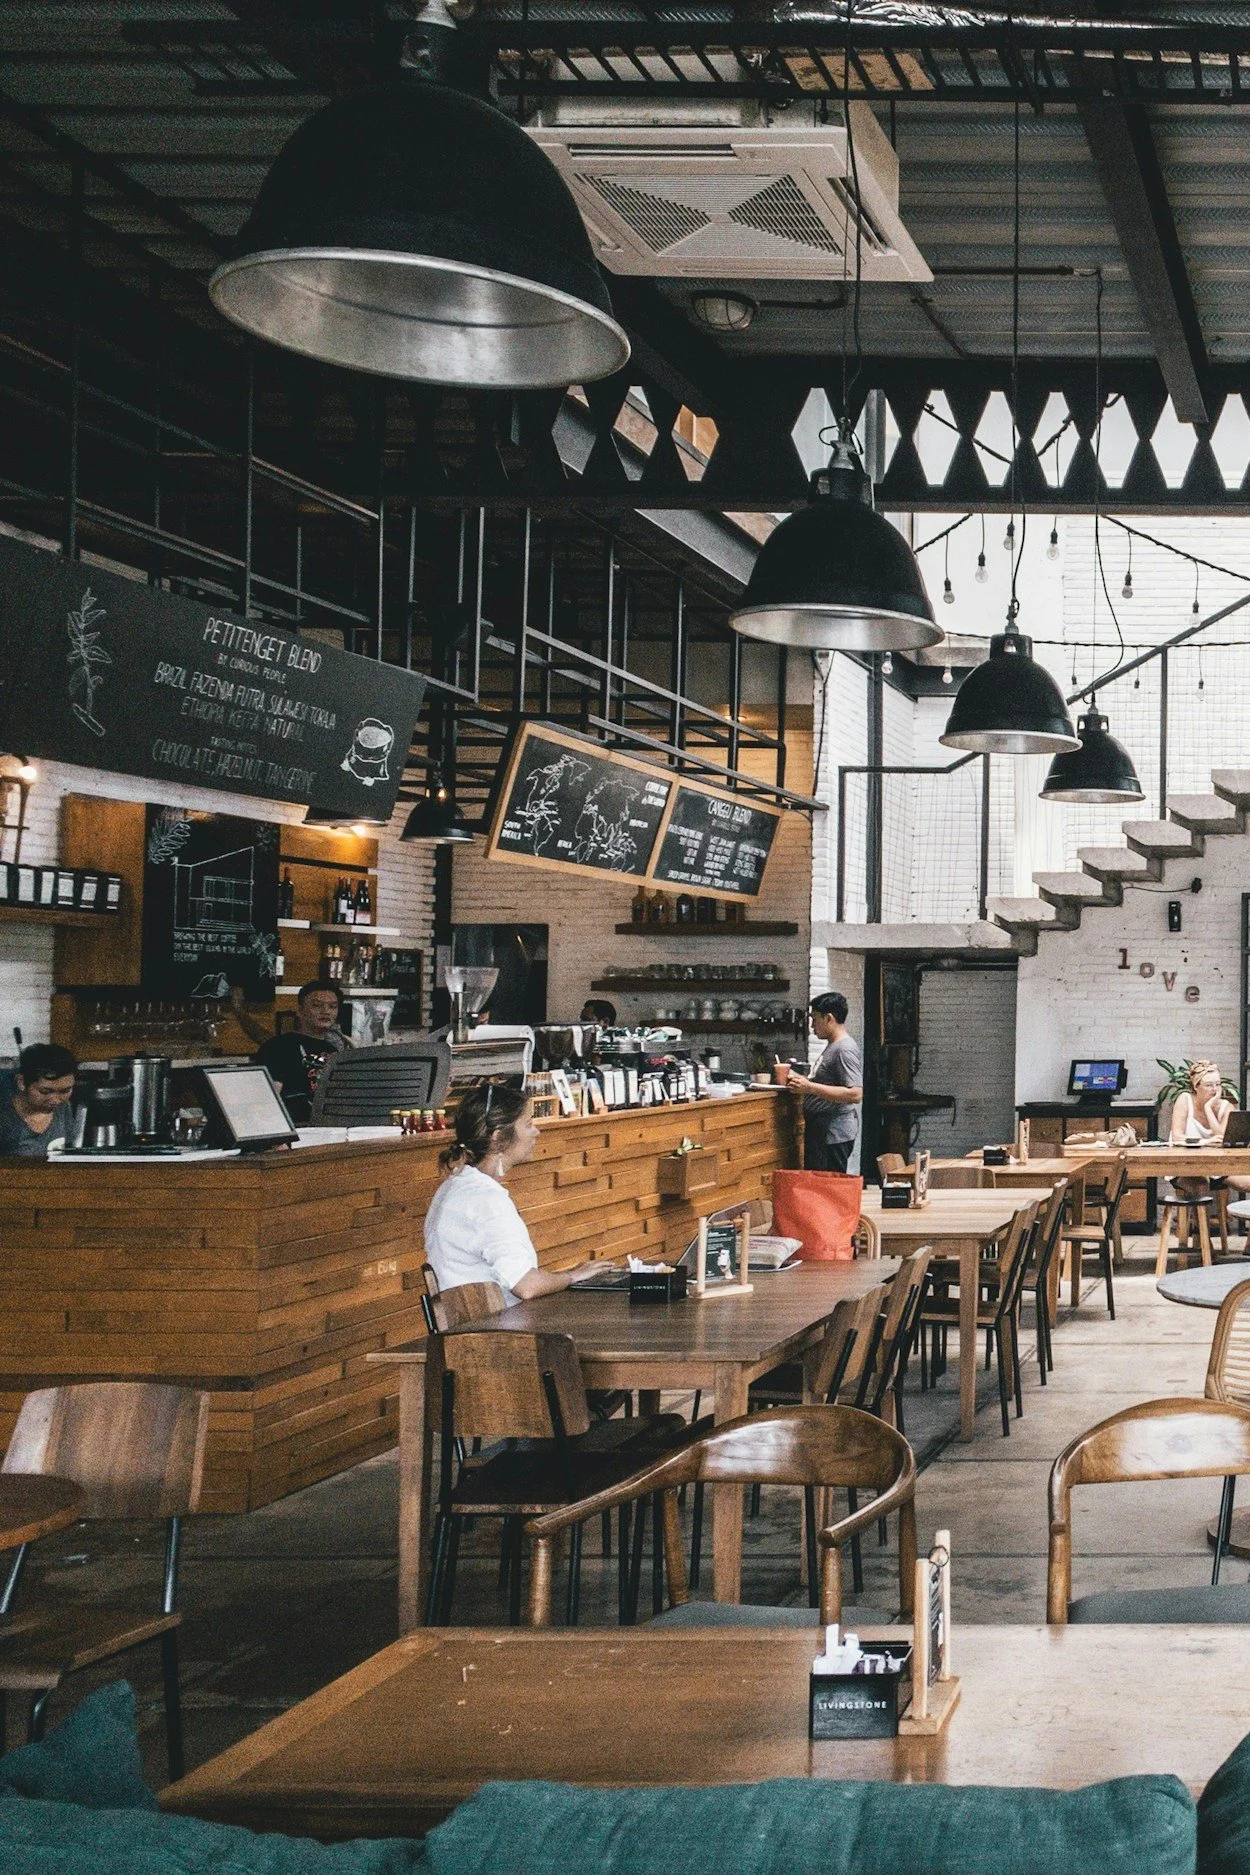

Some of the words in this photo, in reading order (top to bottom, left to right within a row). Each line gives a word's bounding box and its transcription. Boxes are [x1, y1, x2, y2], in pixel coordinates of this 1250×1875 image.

[203, 617, 287, 662] PETITENGET
[287, 644, 322, 673] BLEND
[154, 661, 187, 690] BRAZIL
[189, 671, 235, 701] FAZENDA
[217, 653, 226, 665] BY
[229, 657, 259, 674] CURIOUS
[263, 667, 287, 684] PEOPLE
[180, 696, 225, 724] ETHIOPIA
[732, 806, 752, 825] BLEND
[1118, 948, 1200, 1003] love
[818, 1700, 887, 1710] LIVINGSTONE
